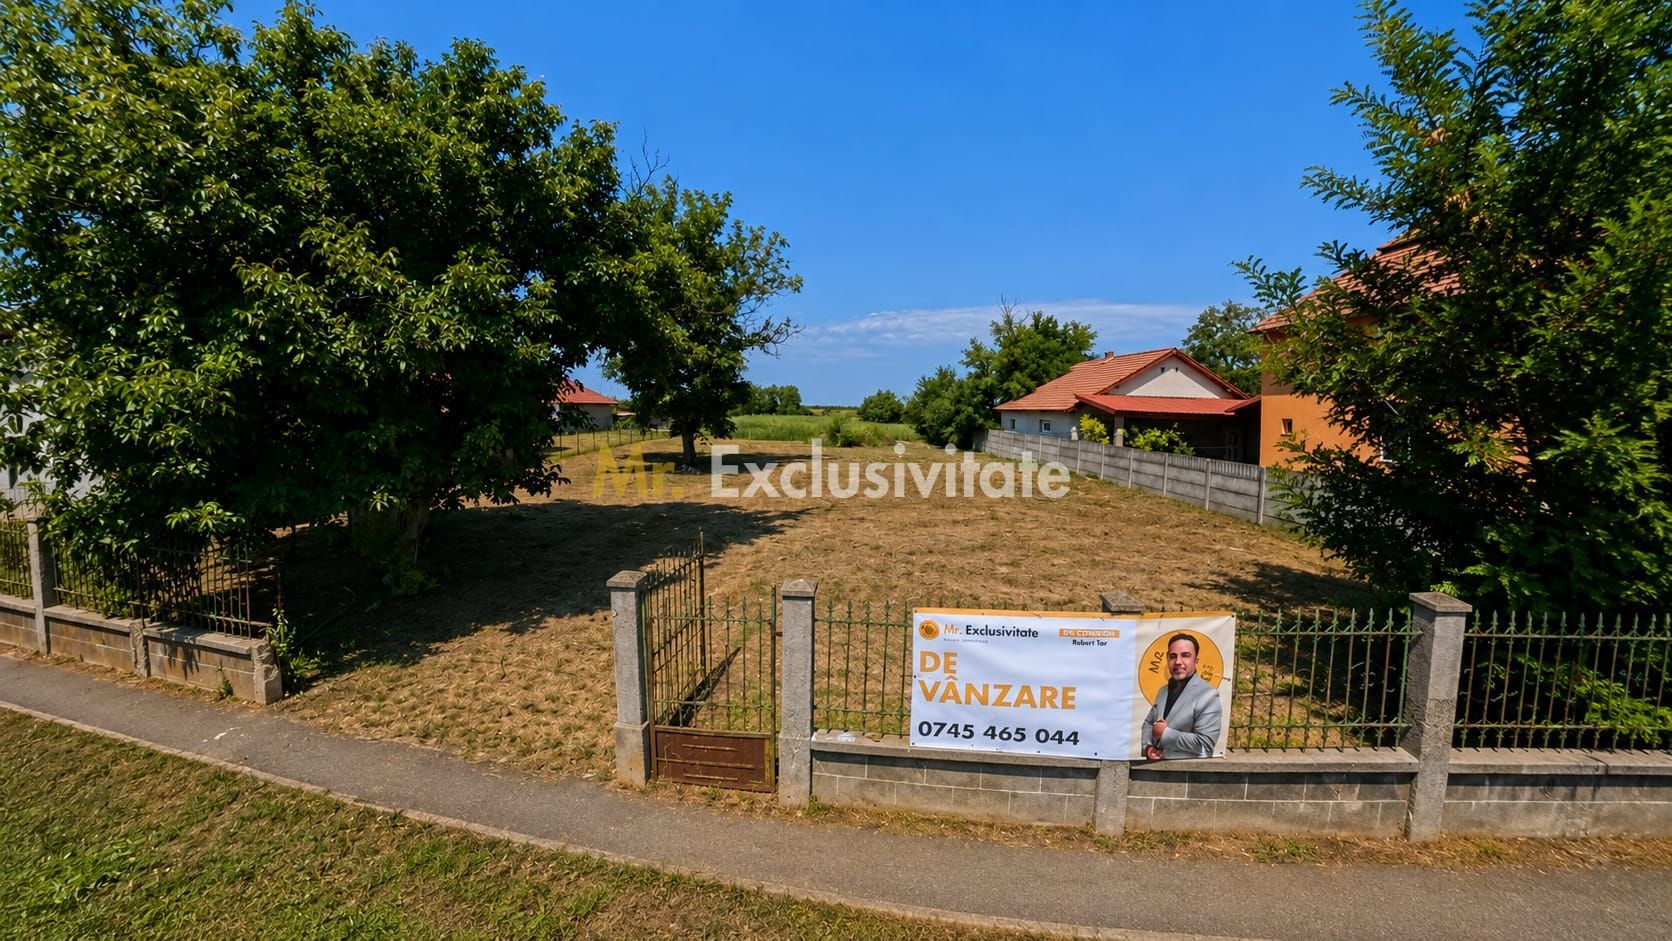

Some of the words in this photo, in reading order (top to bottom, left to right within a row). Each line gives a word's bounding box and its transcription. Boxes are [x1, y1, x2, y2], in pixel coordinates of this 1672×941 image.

[944, 624, 962, 635] Mr.
[965, 624, 1039, 638] Exclusivitate
[919, 651, 957, 674] DE
[918, 675, 1077, 710] VÂNZARE
[918, 721, 975, 739] 0745
[983, 725, 1026, 742] 465
[1035, 728, 1079, 745] 044
